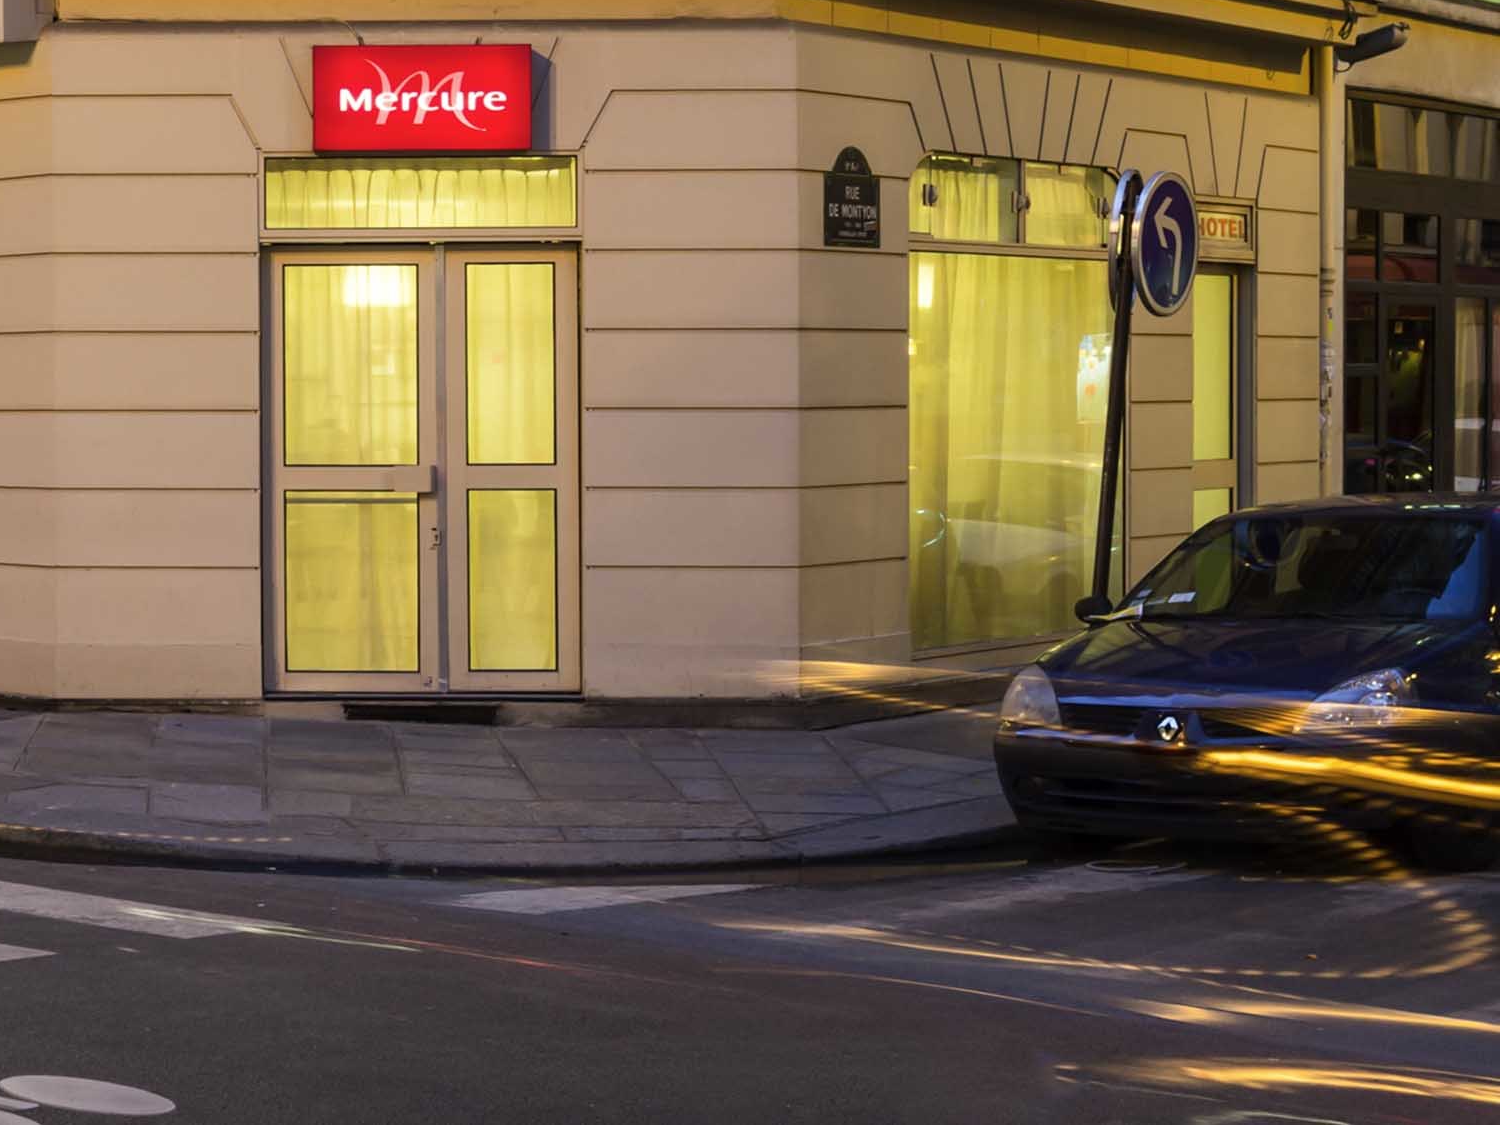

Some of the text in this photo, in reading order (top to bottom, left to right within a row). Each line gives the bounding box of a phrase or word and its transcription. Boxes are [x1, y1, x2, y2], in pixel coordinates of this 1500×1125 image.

[338, 87, 508, 112] Mercure
[845, 185, 861, 200] RUE
[828, 202, 877, 220] DE MONTYON
